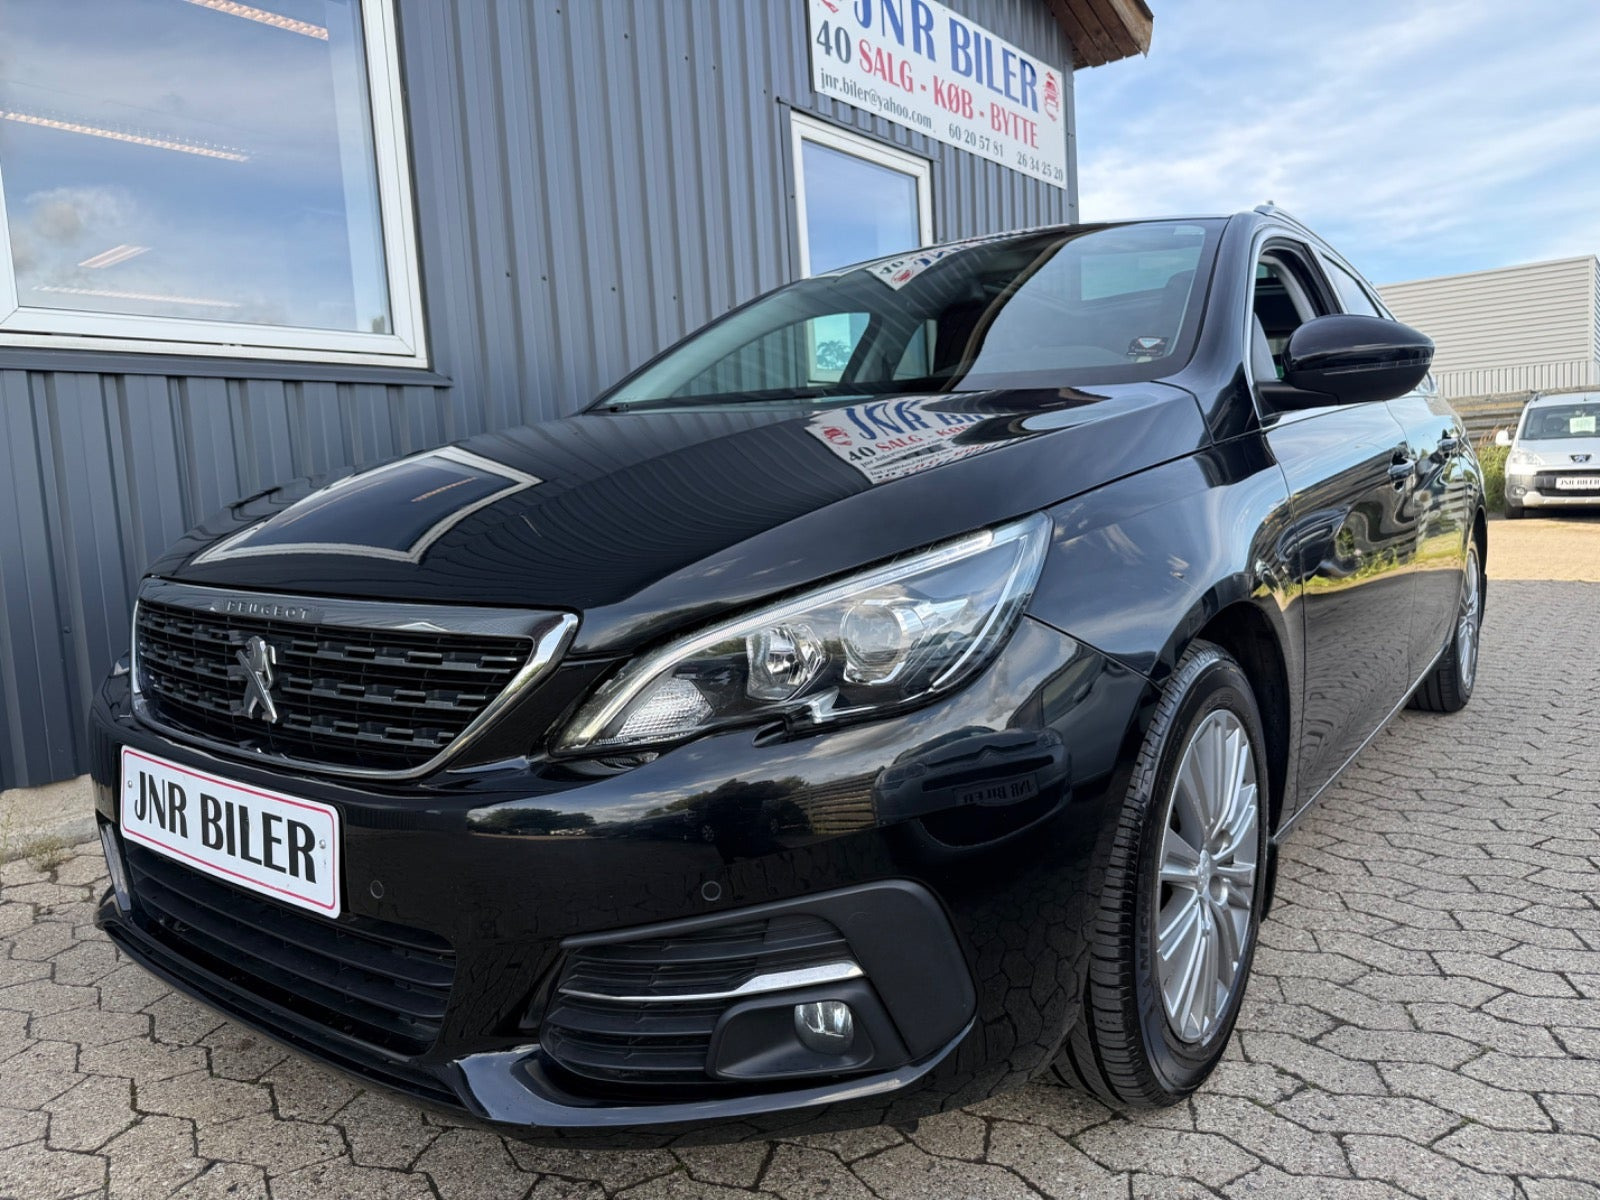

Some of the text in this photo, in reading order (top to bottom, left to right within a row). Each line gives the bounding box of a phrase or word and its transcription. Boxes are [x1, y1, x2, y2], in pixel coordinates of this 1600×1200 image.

[816, 20, 851, 64] 40
[949, 17, 1039, 113] BILER
[820, 67, 932, 129] jnr.biler@yahoo.com
[858, 39, 914, 94] SALG
[933, 75, 974, 120] KØB
[990, 102, 1039, 150] BYTTE
[227, 601, 309, 620] PEUGEOT
[134, 771, 317, 884] JNR BILER
